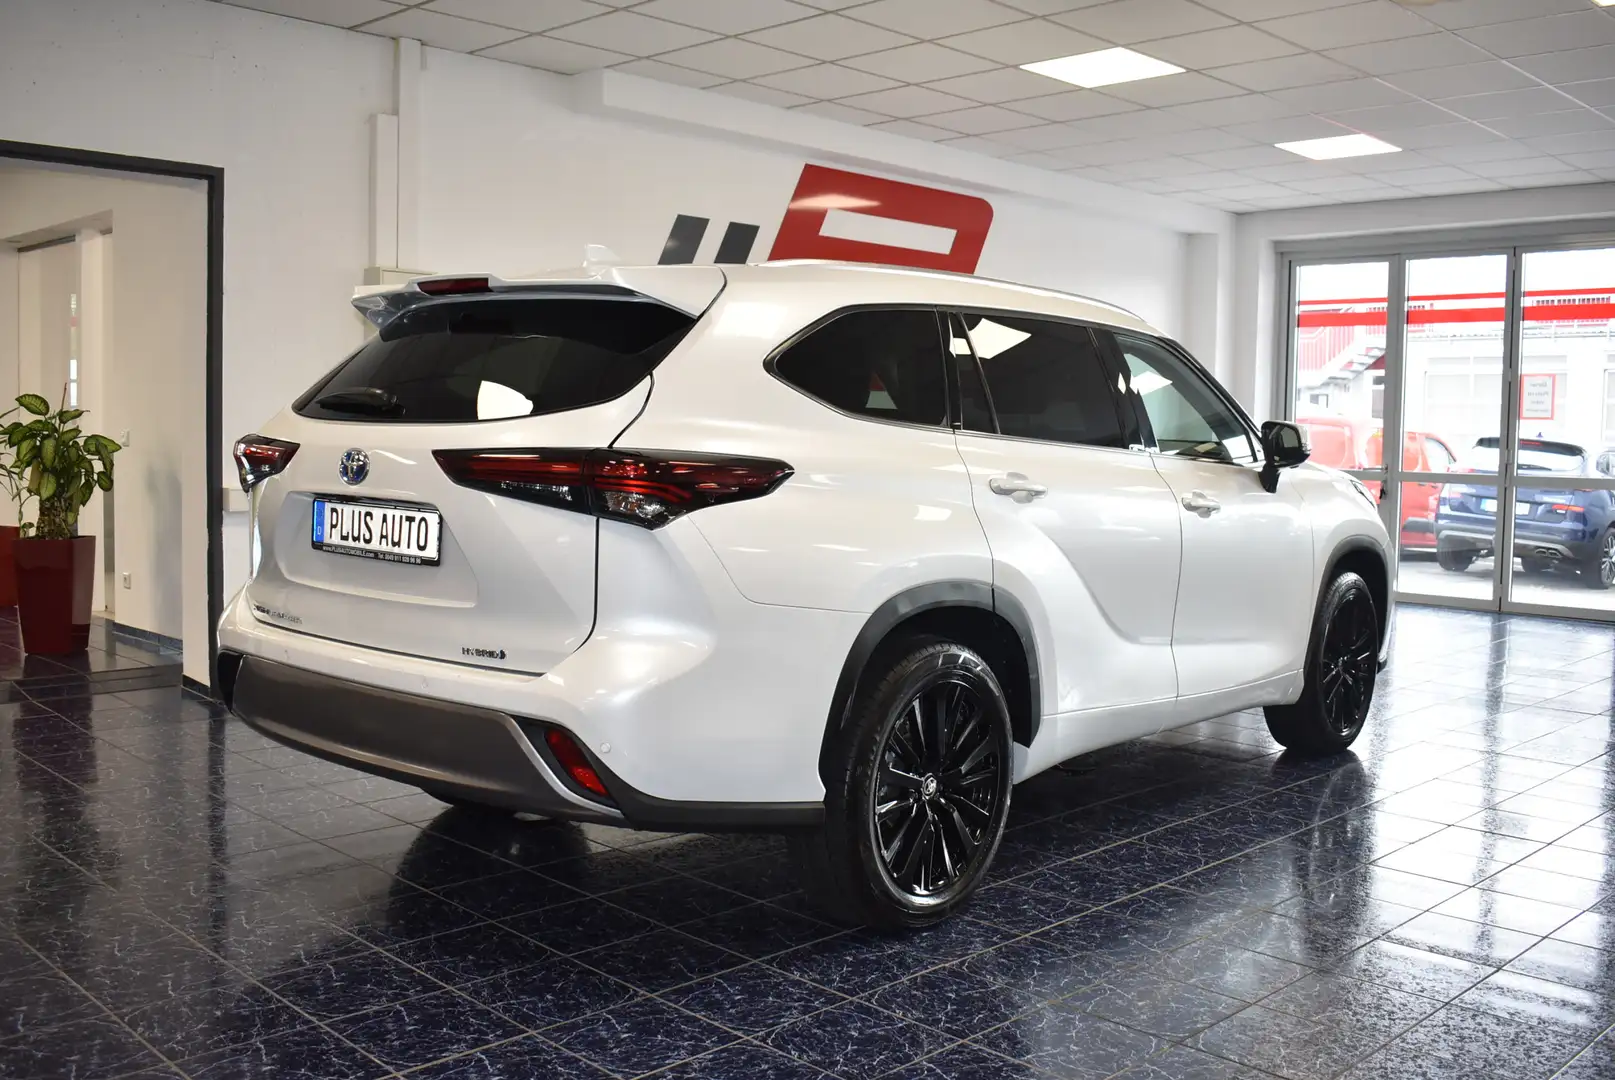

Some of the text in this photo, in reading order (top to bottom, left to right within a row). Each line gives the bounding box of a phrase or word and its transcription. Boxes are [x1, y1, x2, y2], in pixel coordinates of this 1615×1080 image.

[329, 507, 429, 552] PLUS AUTO
[461, 646, 499, 659] HYBRID
